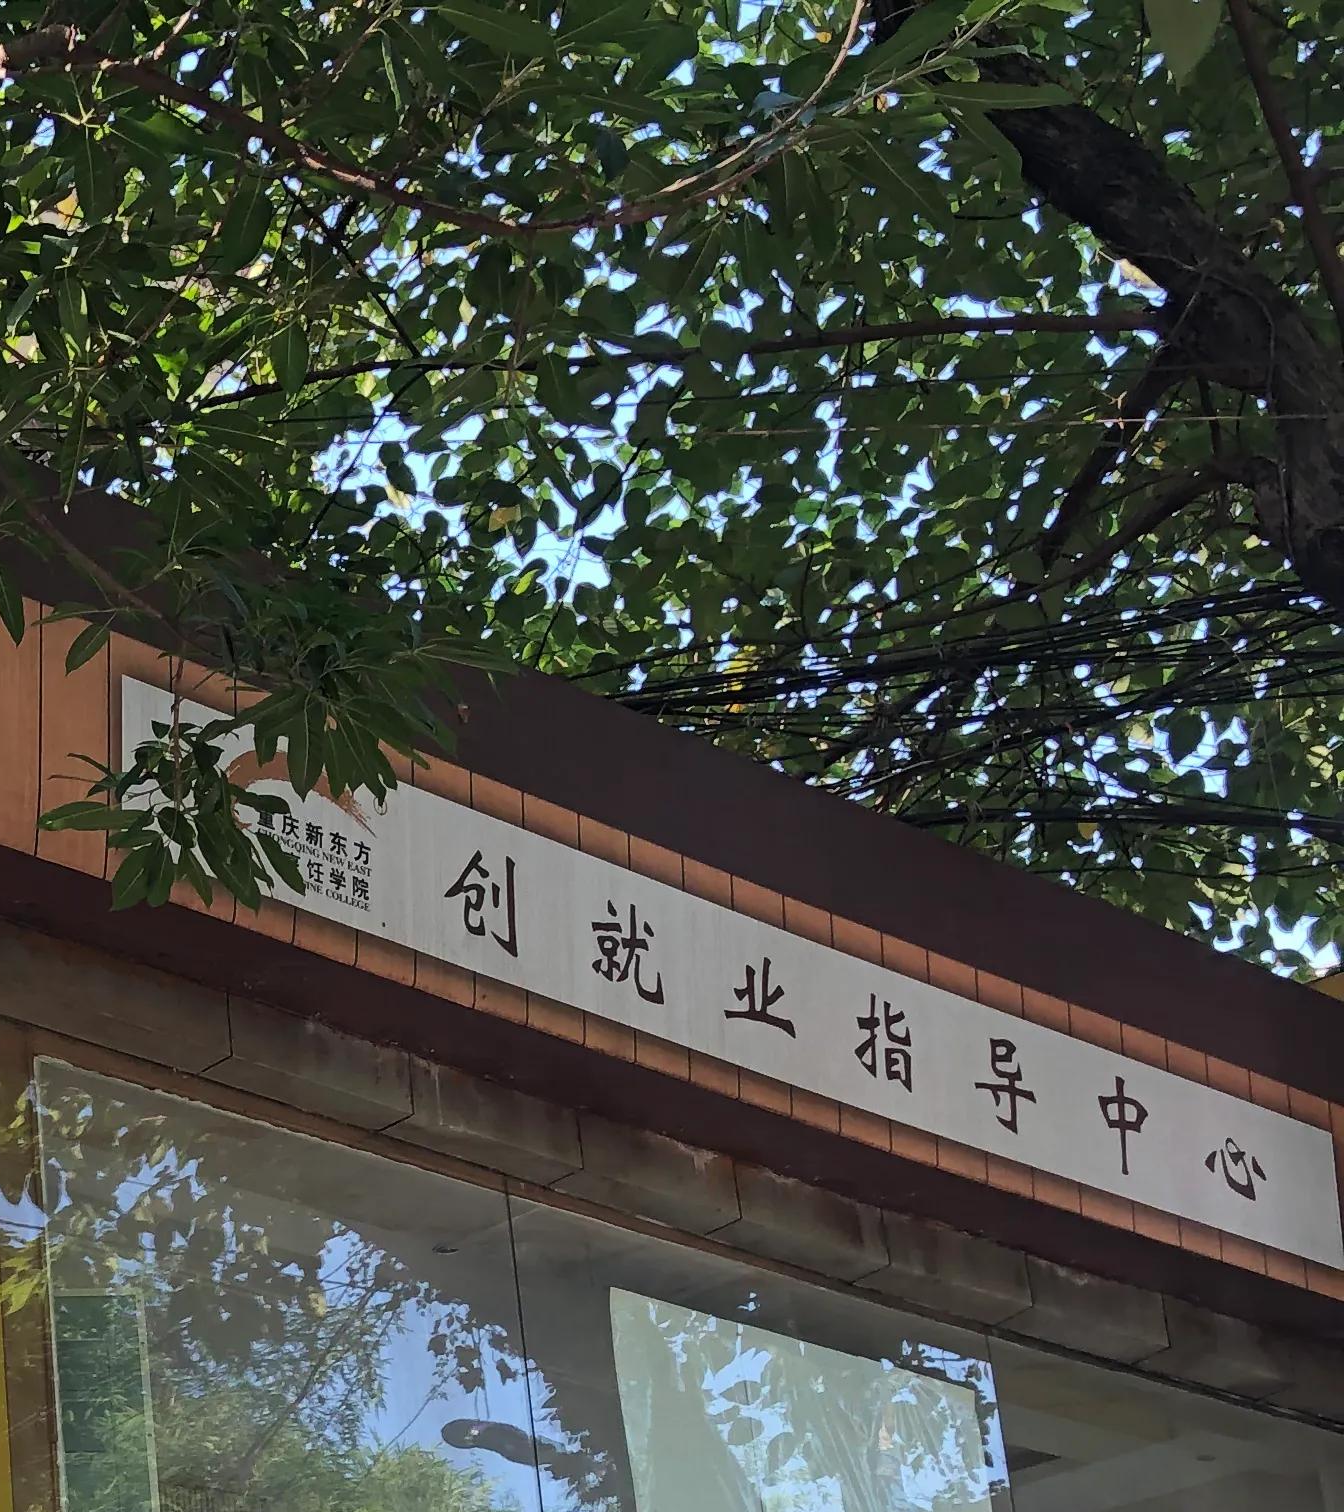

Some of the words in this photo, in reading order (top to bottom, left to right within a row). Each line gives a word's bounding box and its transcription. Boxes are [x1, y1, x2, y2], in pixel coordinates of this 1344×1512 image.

[257, 811, 371, 866] 重庆新东方
[322, 851, 345, 868] NEW
[347, 861, 372, 878] EAST
[325, 888, 370, 912] COLLEGE
[444, 849, 1266, 1200] 创就业指导中心
